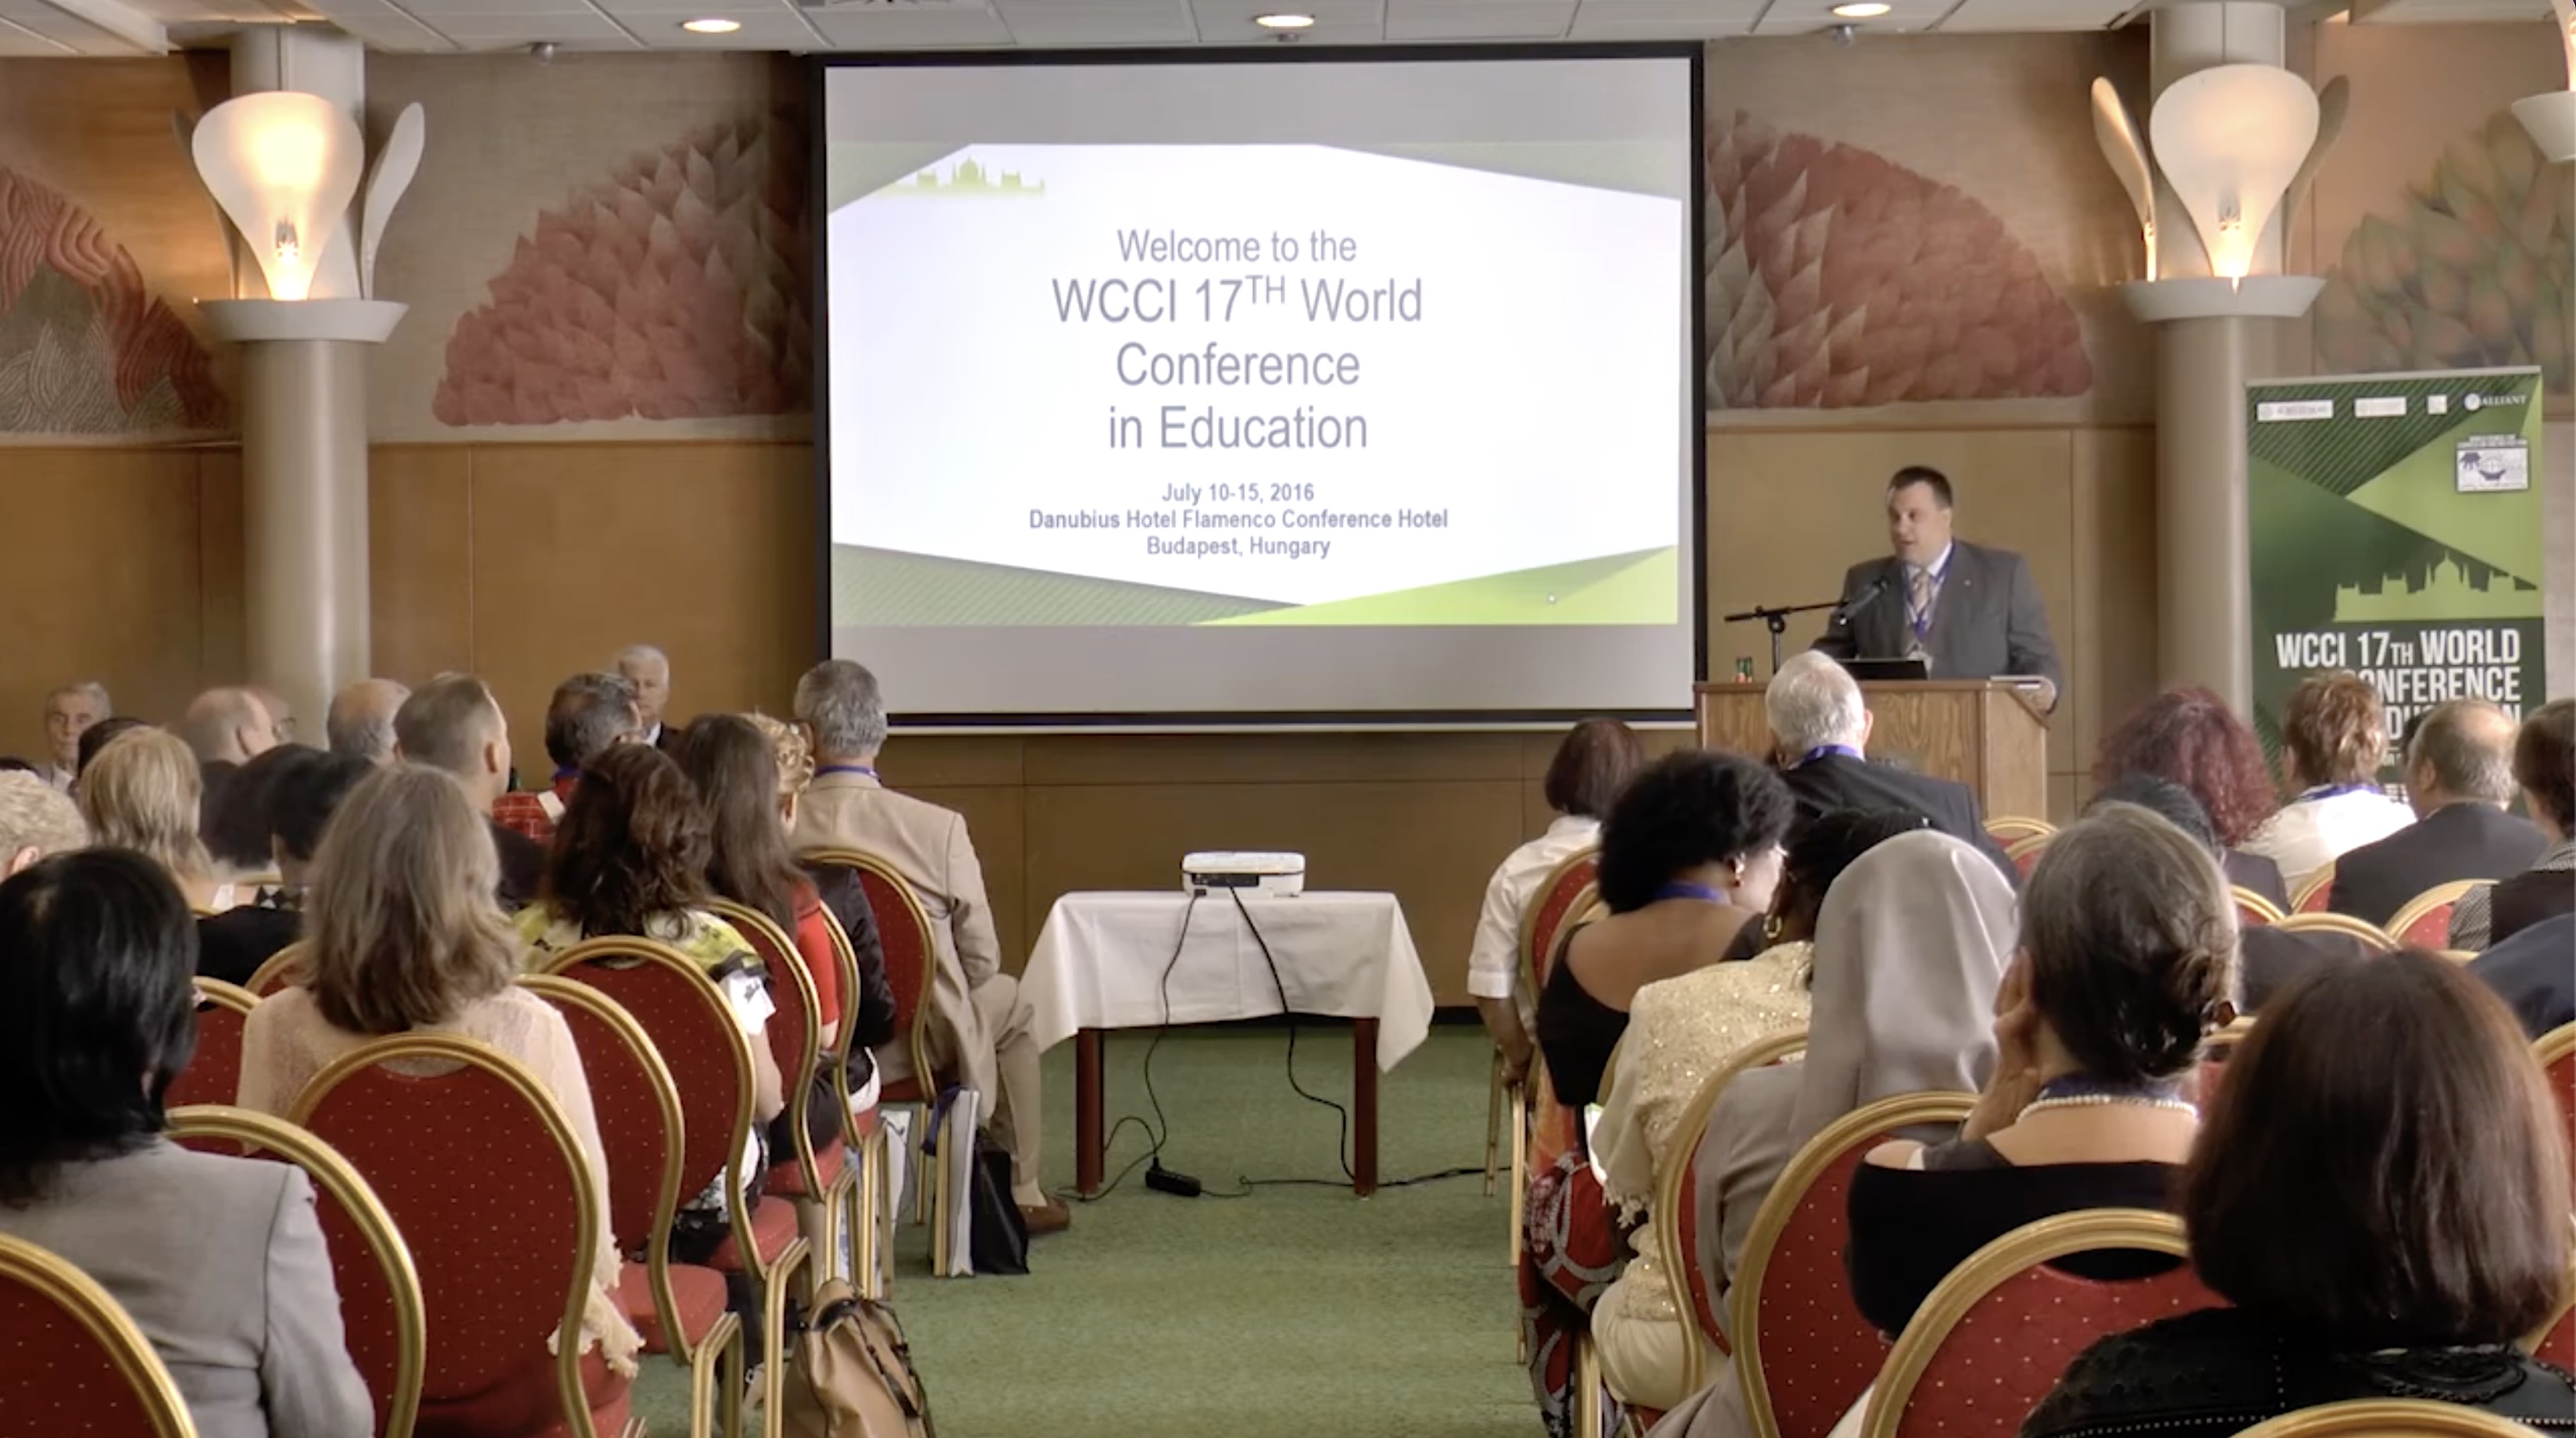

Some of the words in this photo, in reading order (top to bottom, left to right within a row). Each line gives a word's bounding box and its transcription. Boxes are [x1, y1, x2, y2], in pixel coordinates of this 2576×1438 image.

[1117, 229, 1260, 263] Welcome
[1271, 231, 1299, 263] to
[1309, 229, 1357, 263] the
[1052, 277, 1176, 323] WCCI
[1195, 274, 1286, 322] 17TH
[1300, 277, 1422, 322] World
[1117, 341, 1360, 386] Conference
[2481, 394, 2527, 406] ALLIANT
[1109, 405, 1142, 449] in
[1160, 405, 1367, 449] Education
[1161, 482, 1202, 506] July
[1209, 482, 1263, 504] 10-15,
[1270, 482, 1314, 502] 2016
[1029, 509, 1120, 529] Danubius
[1127, 509, 1177, 528] Hotel
[1183, 509, 1276, 528] Flamenco
[1281, 508, 1392, 528] Conference
[1398, 508, 1448, 528] Hotel
[1147, 535, 1243, 560] Budapest,
[1250, 535, 1331, 560] Hungary
[2275, 632, 2344, 667] WCCI
[2357, 631, 2413, 666] 17TH
[2420, 629, 2521, 665] WORLD
[2342, 667, 2521, 703] NFERENCE
